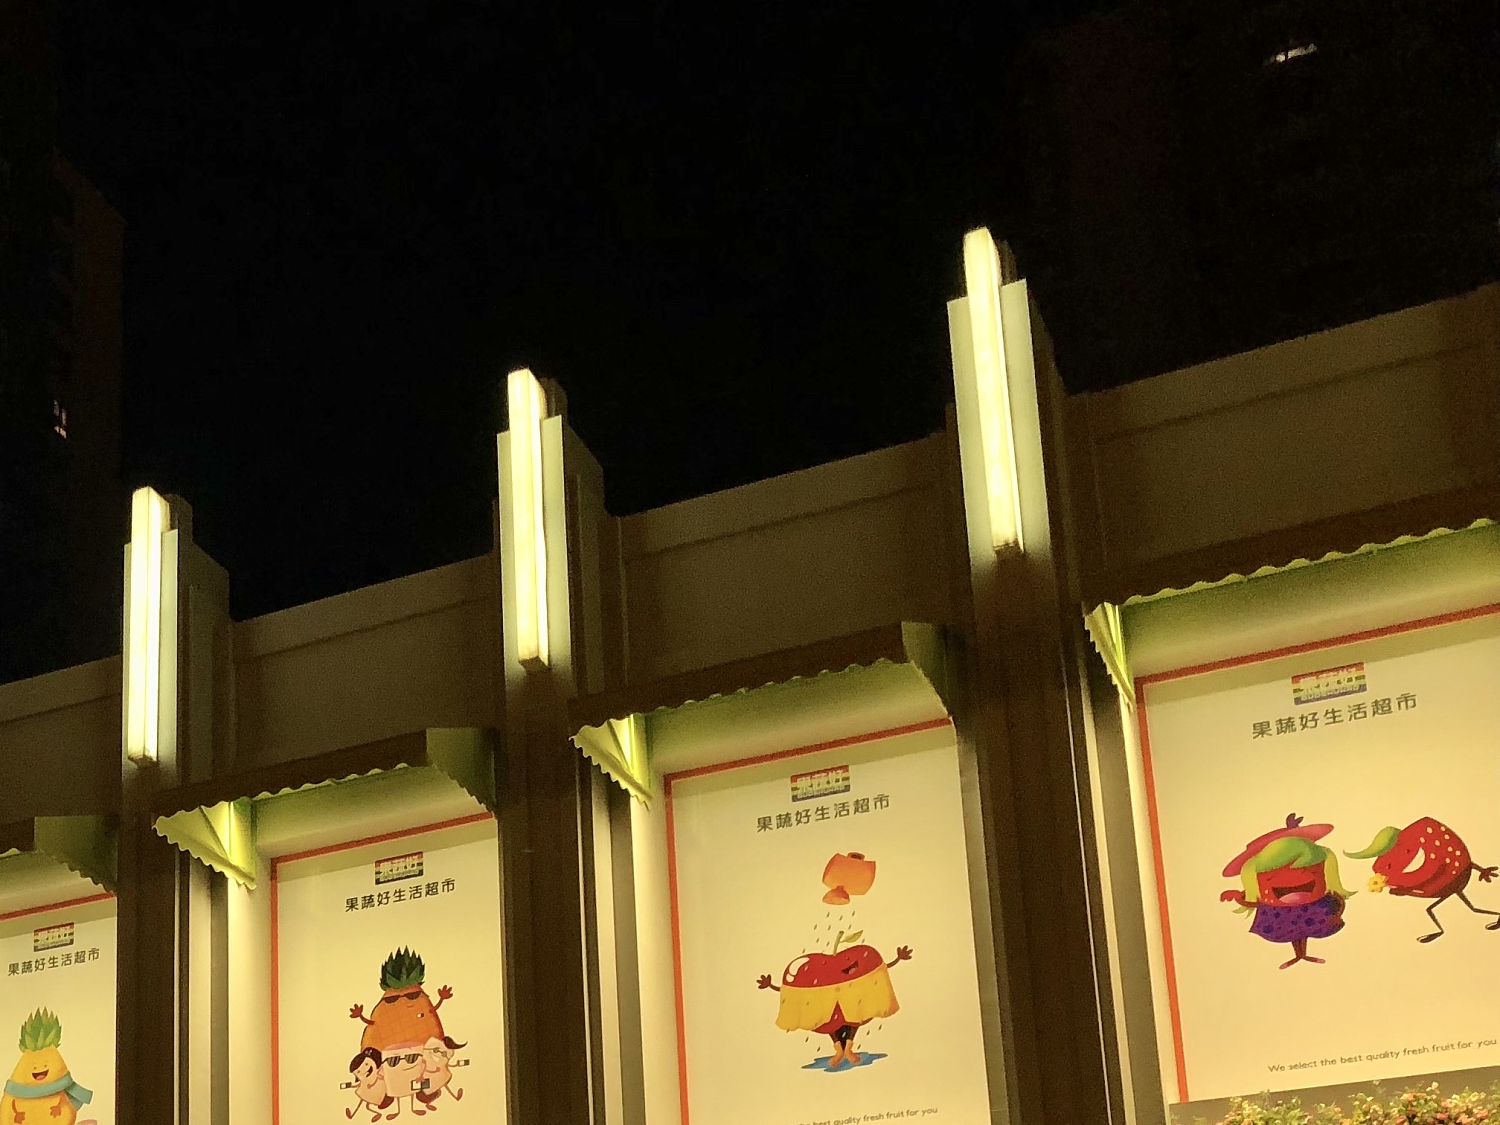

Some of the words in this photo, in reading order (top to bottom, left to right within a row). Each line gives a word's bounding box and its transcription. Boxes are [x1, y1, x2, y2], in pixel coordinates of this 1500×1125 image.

[1252, 692, 1417, 740] 果蔬好生活超市
[757, 793, 890, 833] 果蔬好生活超市
[345, 877, 456, 912] 果蔬好生活超市
[1267, 1063, 1286, 1073] We
[1288, 1060, 1317, 1071] select
[1320, 1057, 1337, 1067] the
[1340, 1054, 1363, 1064] best
[1365, 1050, 1401, 1062] quality
[1403, 1045, 1430, 1056] fresh
[1431, 1042, 1455, 1053] fruit
[1457, 1040, 1473, 1050] for
[1476, 1038, 1497, 1049] you
[863, 1112, 884, 1122] fresh
[886, 1110, 904, 1119] fruit
[906, 1108, 919, 1117] for
[921, 1107, 938, 1117] you
